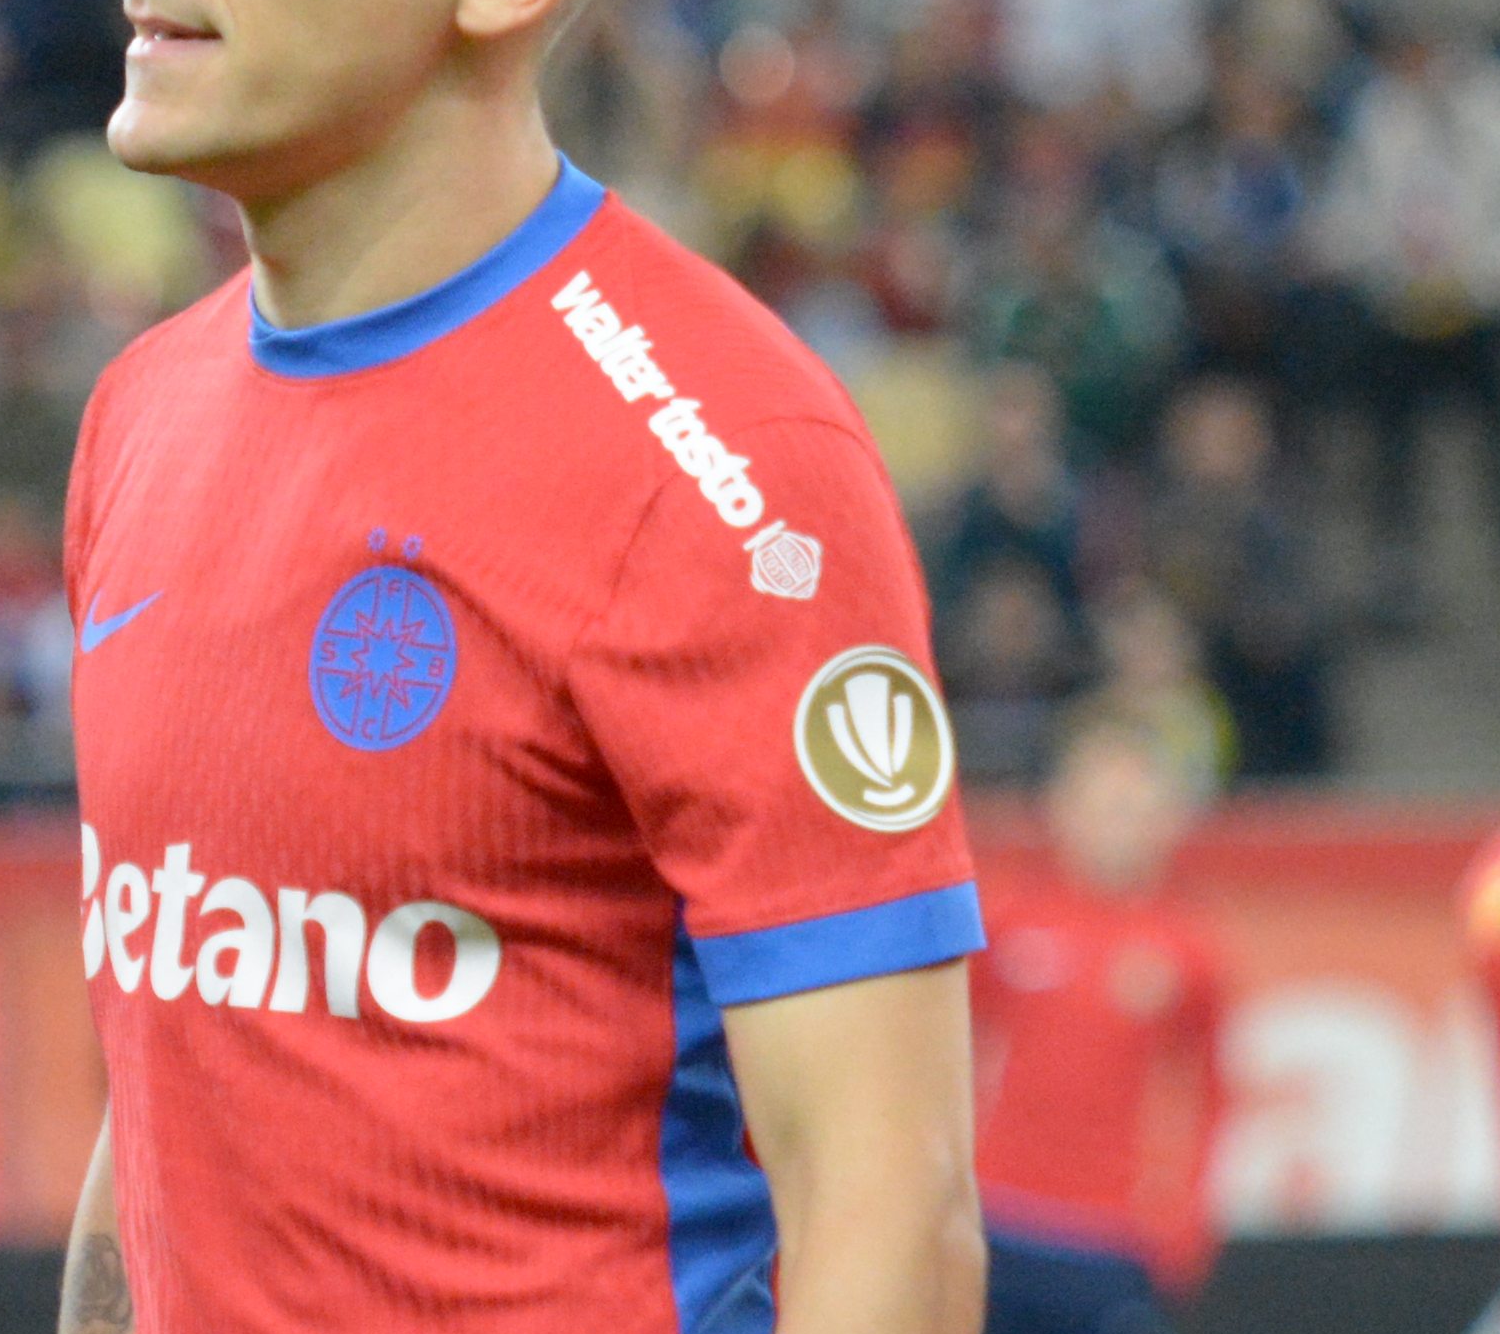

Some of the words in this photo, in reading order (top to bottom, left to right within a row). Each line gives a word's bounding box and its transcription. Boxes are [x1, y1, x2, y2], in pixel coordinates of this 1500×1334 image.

[550, 270, 676, 403] walter
[647, 397, 765, 528] tosto
[386, 578, 402, 599] F
[320, 640, 337, 663] S
[427, 656, 446, 679] B
[360, 718, 378, 741] C
